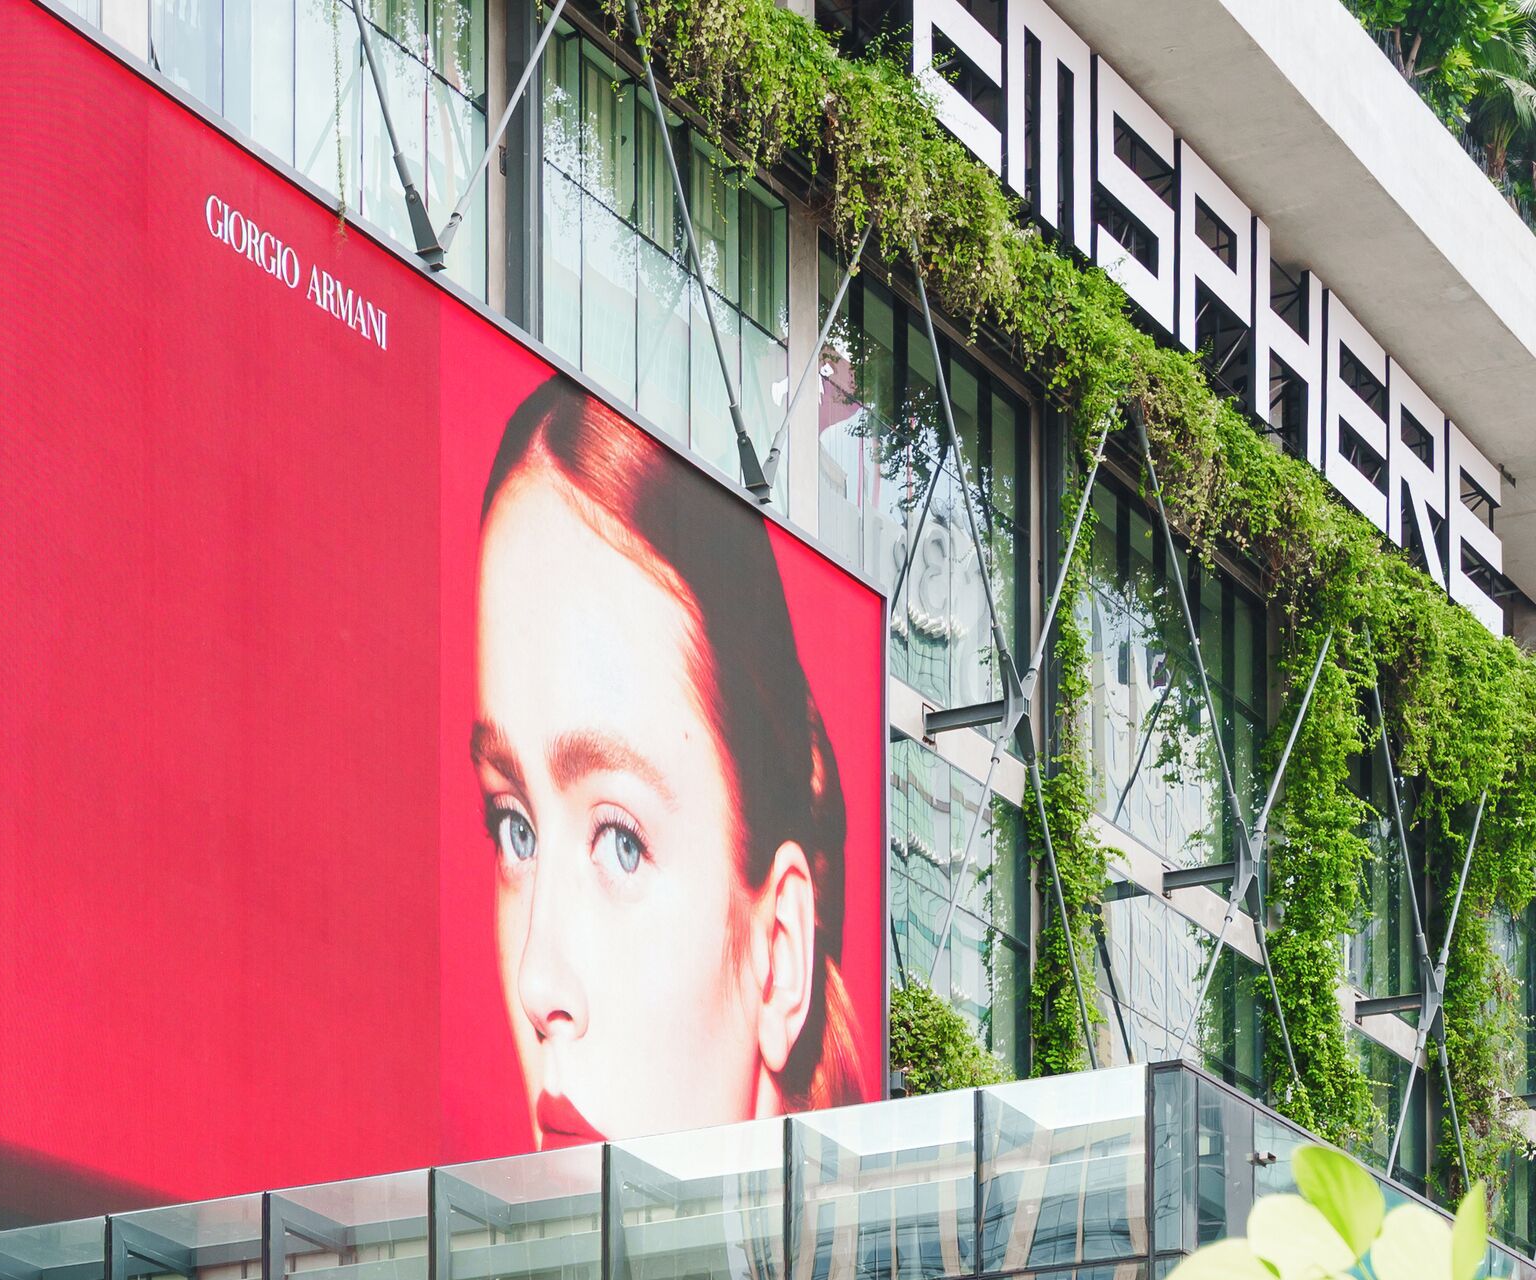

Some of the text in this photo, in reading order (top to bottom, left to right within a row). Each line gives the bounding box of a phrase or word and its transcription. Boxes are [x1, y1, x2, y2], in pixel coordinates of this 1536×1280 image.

[205, 194, 387, 350] GIORGIO ARMANI
[913, 0, 1504, 637] EMSPHERE
